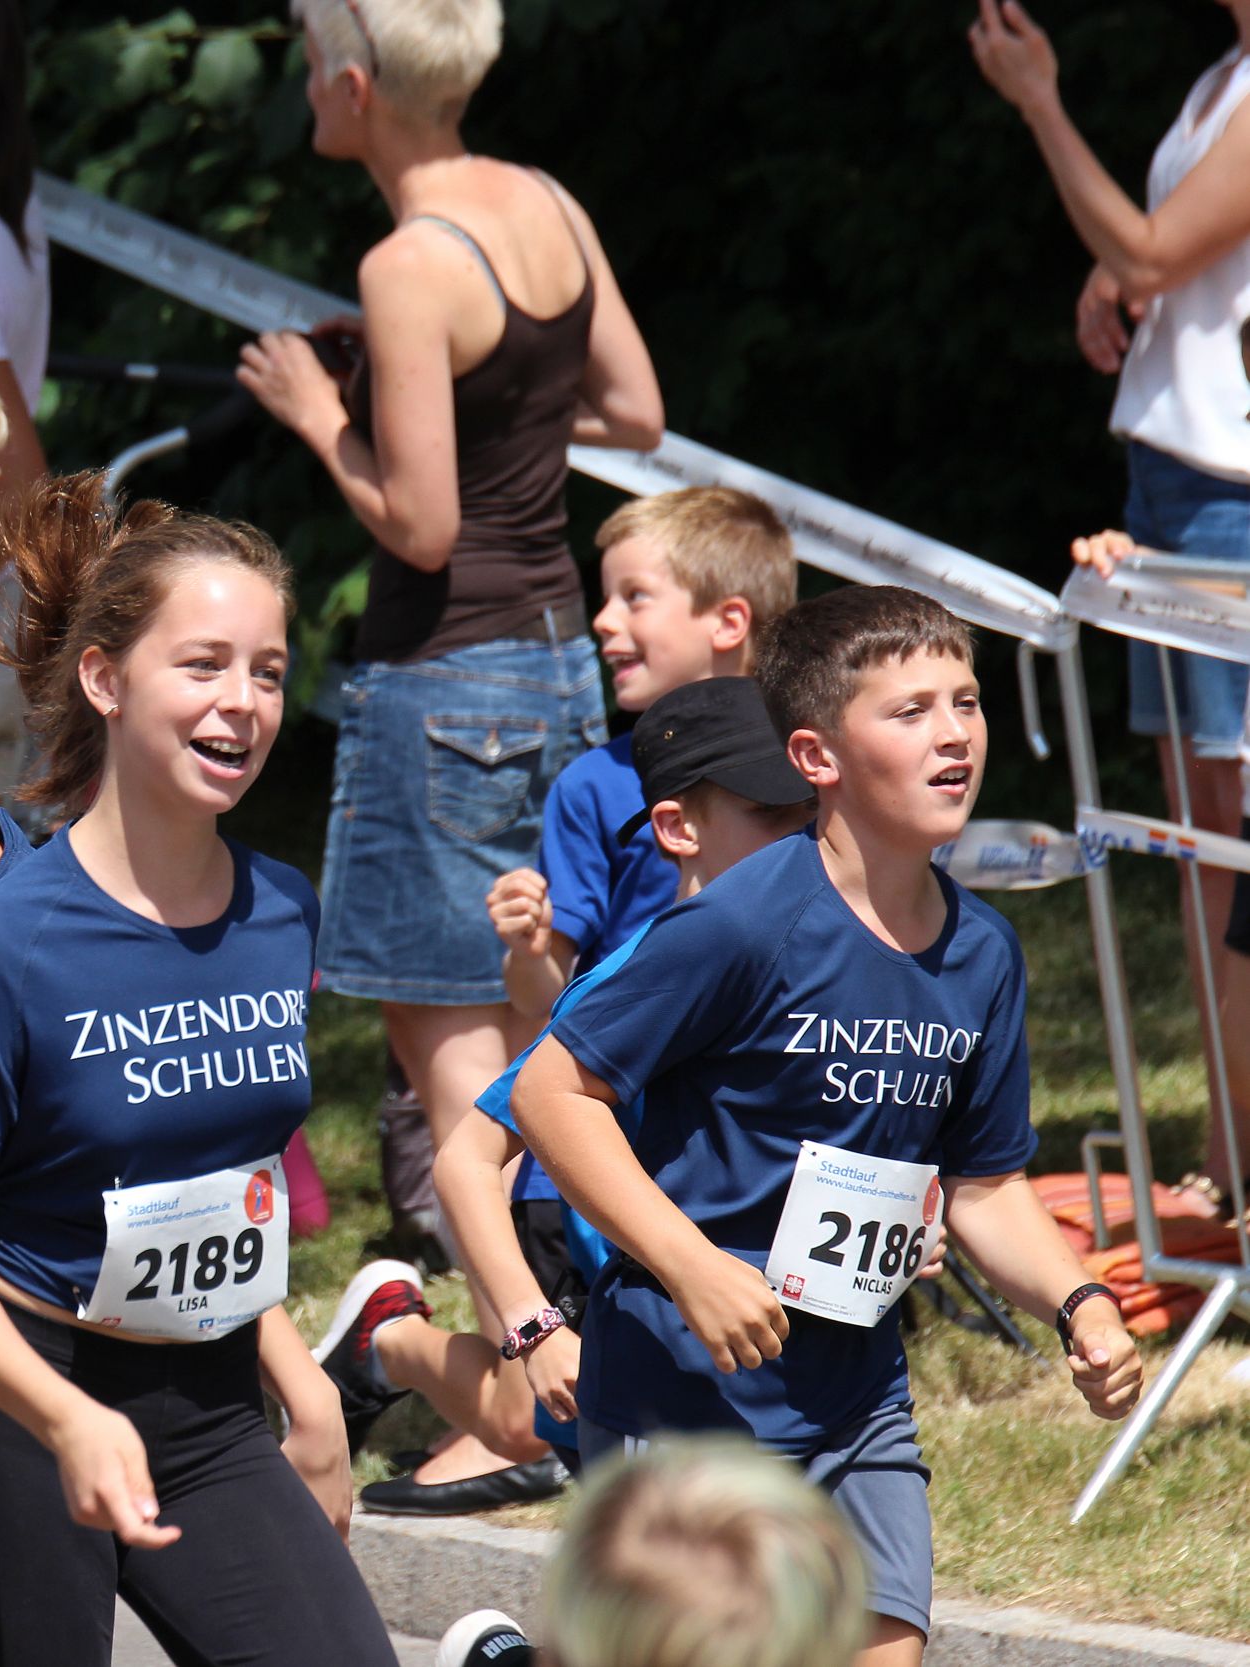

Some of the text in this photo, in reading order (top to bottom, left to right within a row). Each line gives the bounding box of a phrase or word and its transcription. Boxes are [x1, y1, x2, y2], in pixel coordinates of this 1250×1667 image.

[123, 1042, 308, 1104] SCHULEN
[820, 1160, 878, 1183] Stadtlauf
[127, 1197, 181, 1217] Stadtlauf
[808, 1211, 927, 1279] 2186
[125, 1227, 263, 1303] 2189
[852, 1276, 893, 1295] NICLAS
[178, 1296, 208, 1313] LISA
